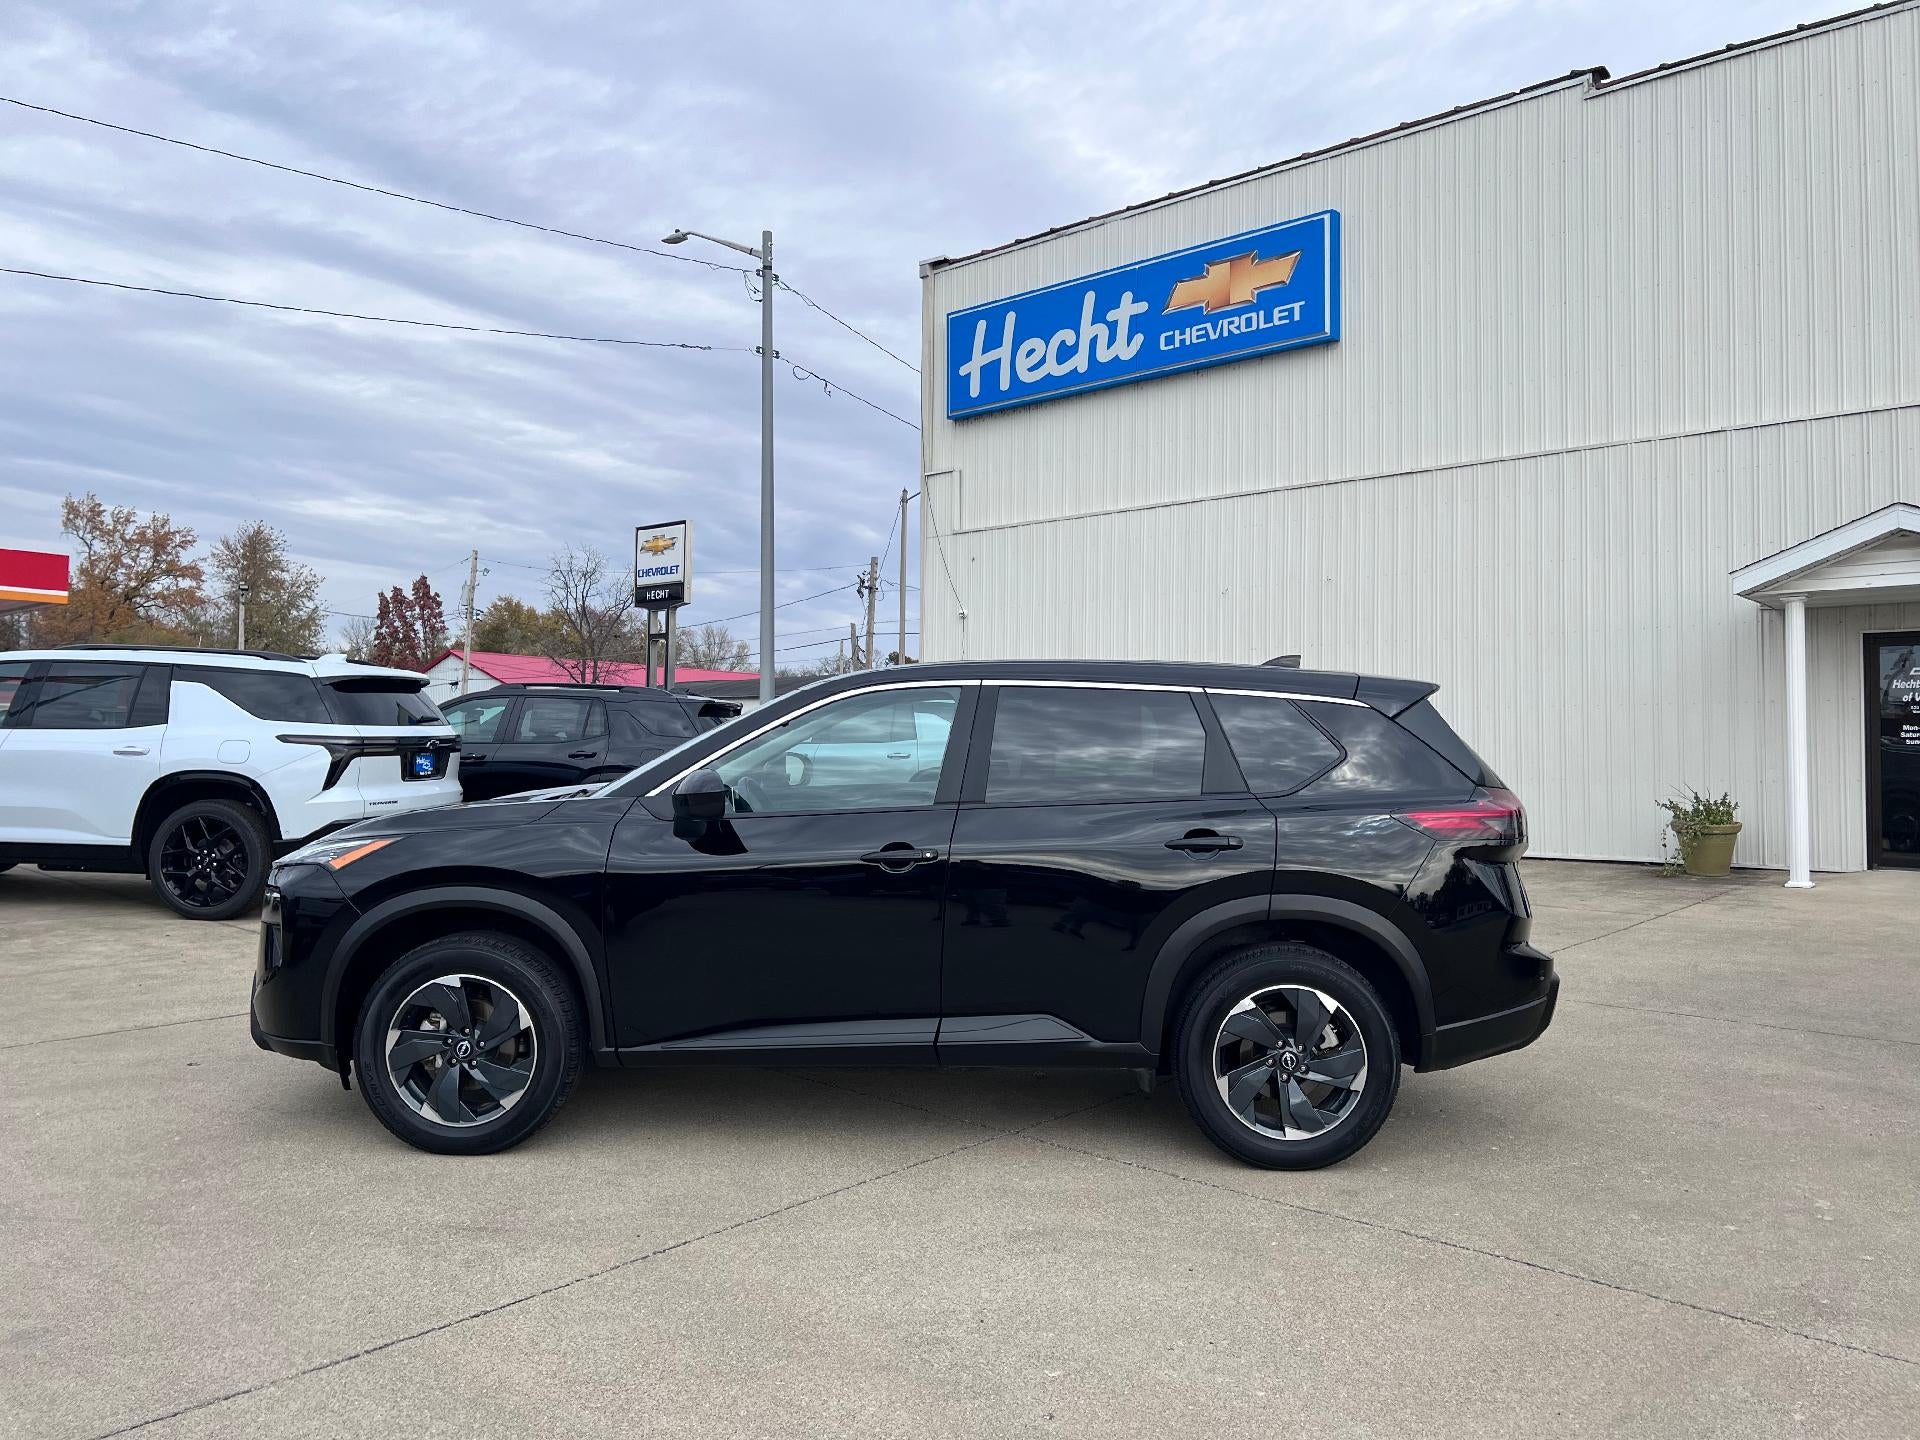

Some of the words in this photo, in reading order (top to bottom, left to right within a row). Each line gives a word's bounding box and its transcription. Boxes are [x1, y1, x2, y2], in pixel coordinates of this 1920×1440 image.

[1159, 300, 1306, 351] CHEVROLET
[958, 290, 1149, 398] Hecht
[638, 565, 679, 578] CHEVROLET
[646, 590, 669, 600] HECHT
